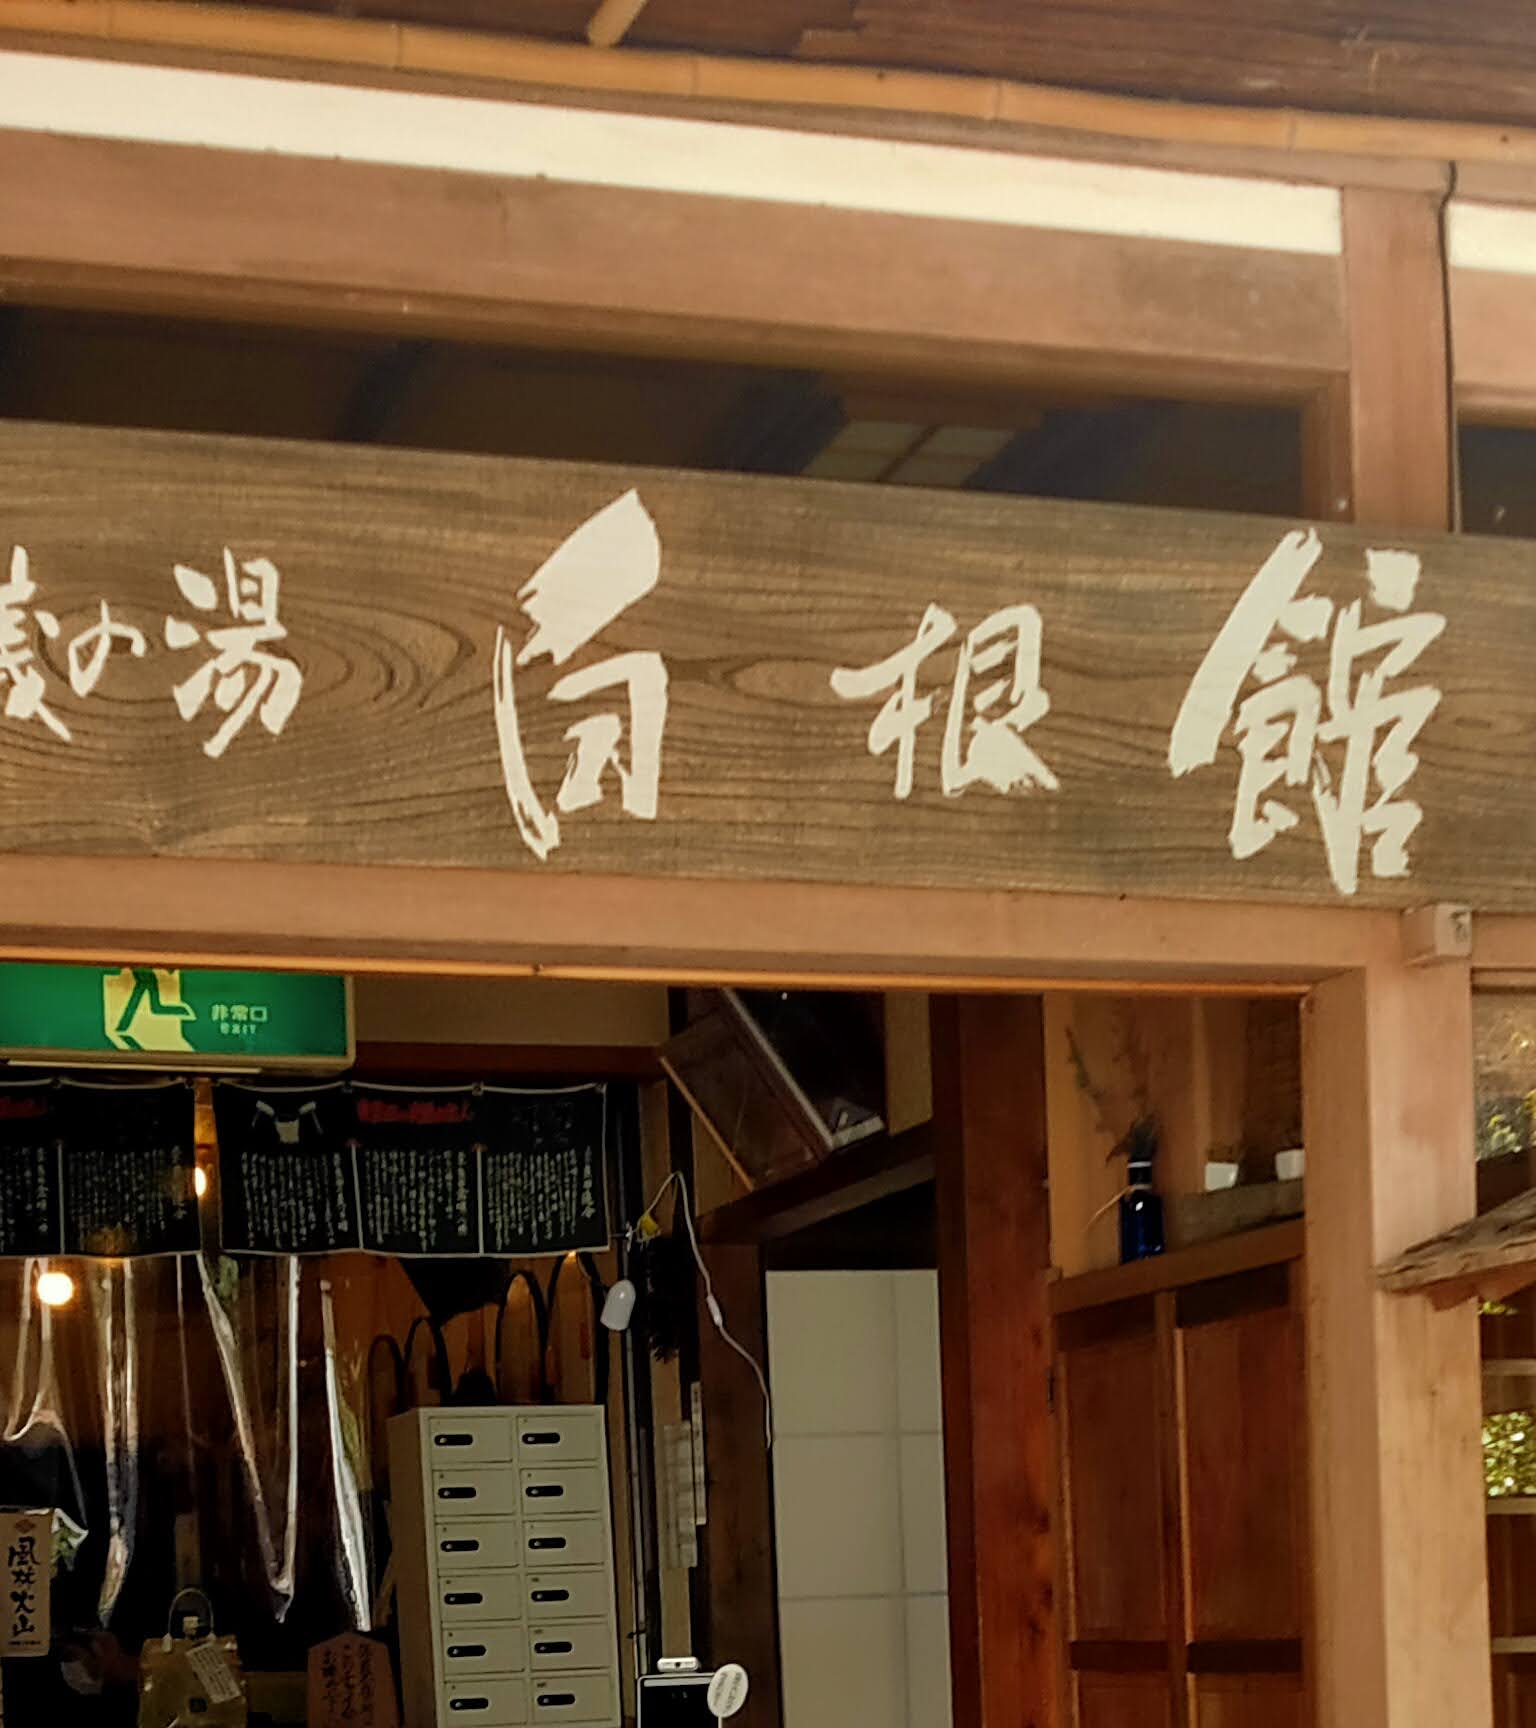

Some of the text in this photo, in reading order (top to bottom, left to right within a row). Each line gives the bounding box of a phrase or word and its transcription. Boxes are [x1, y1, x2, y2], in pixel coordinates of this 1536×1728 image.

[494, 490, 1452, 888] 白根館
[211, 1004, 268, 1021] 非常口
